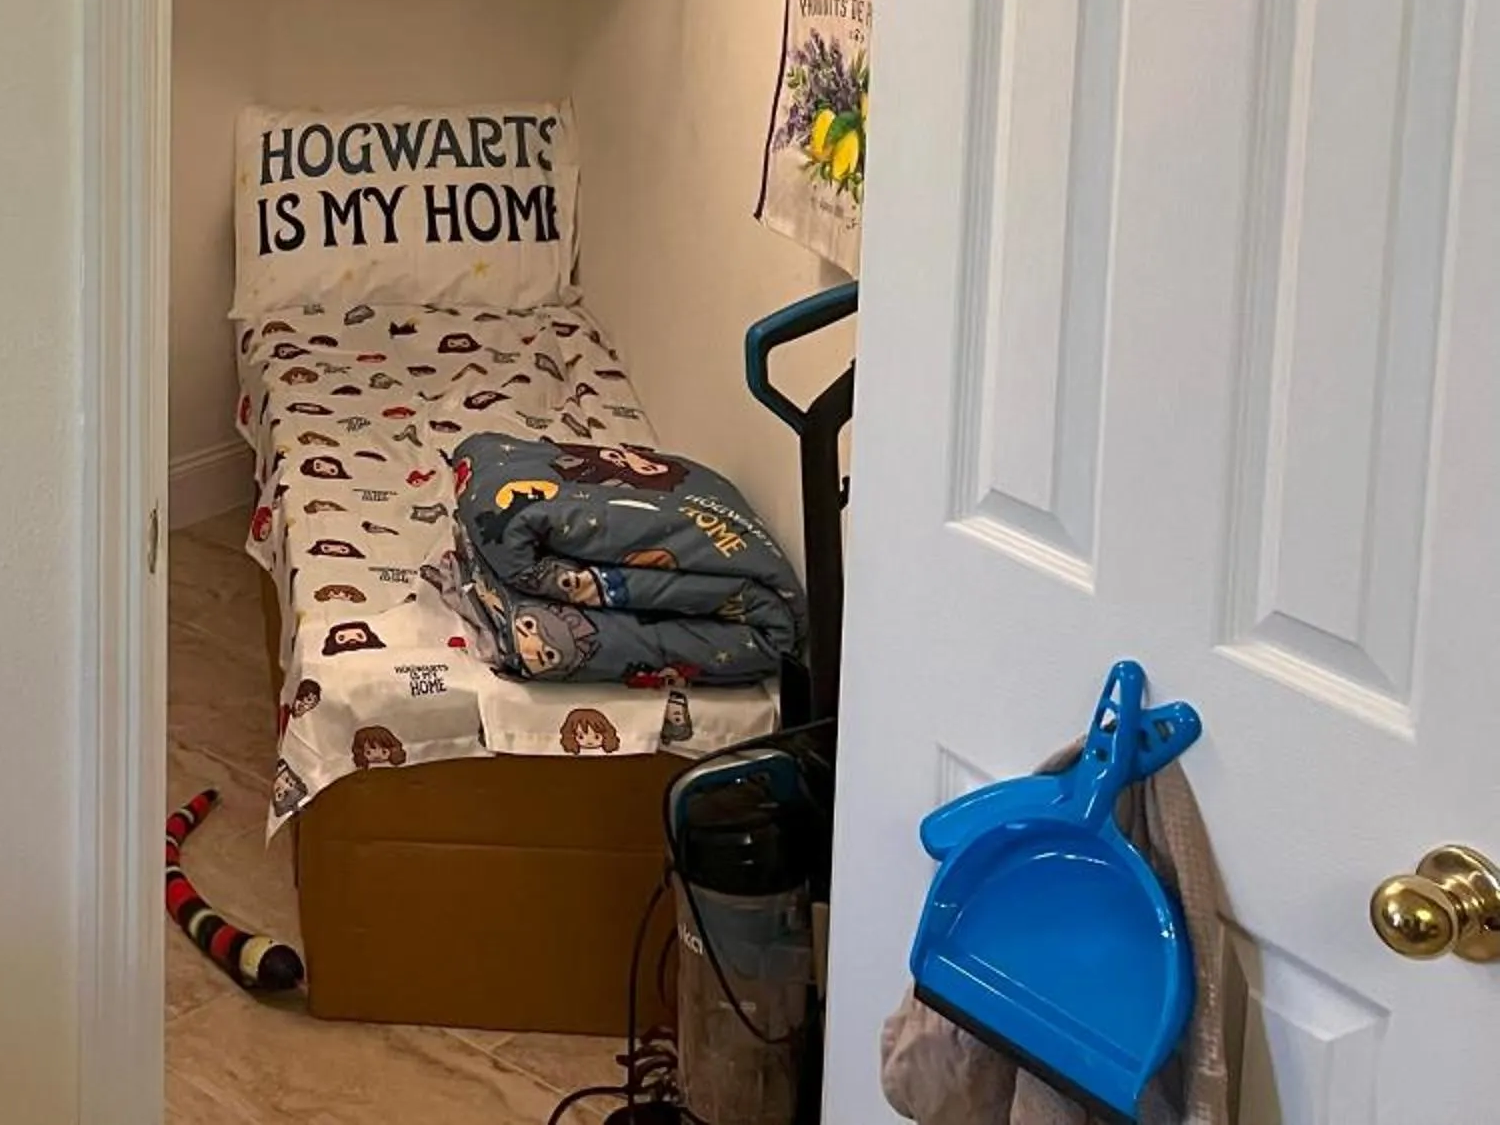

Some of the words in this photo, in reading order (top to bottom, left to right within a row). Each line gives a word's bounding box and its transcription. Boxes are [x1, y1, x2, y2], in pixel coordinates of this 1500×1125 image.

[260, 116, 557, 187] HOGWARTS
[258, 193, 305, 256] IS
[317, 185, 408, 248] MY
[678, 505, 748, 558] HOME
[409, 678, 448, 697] HOME
